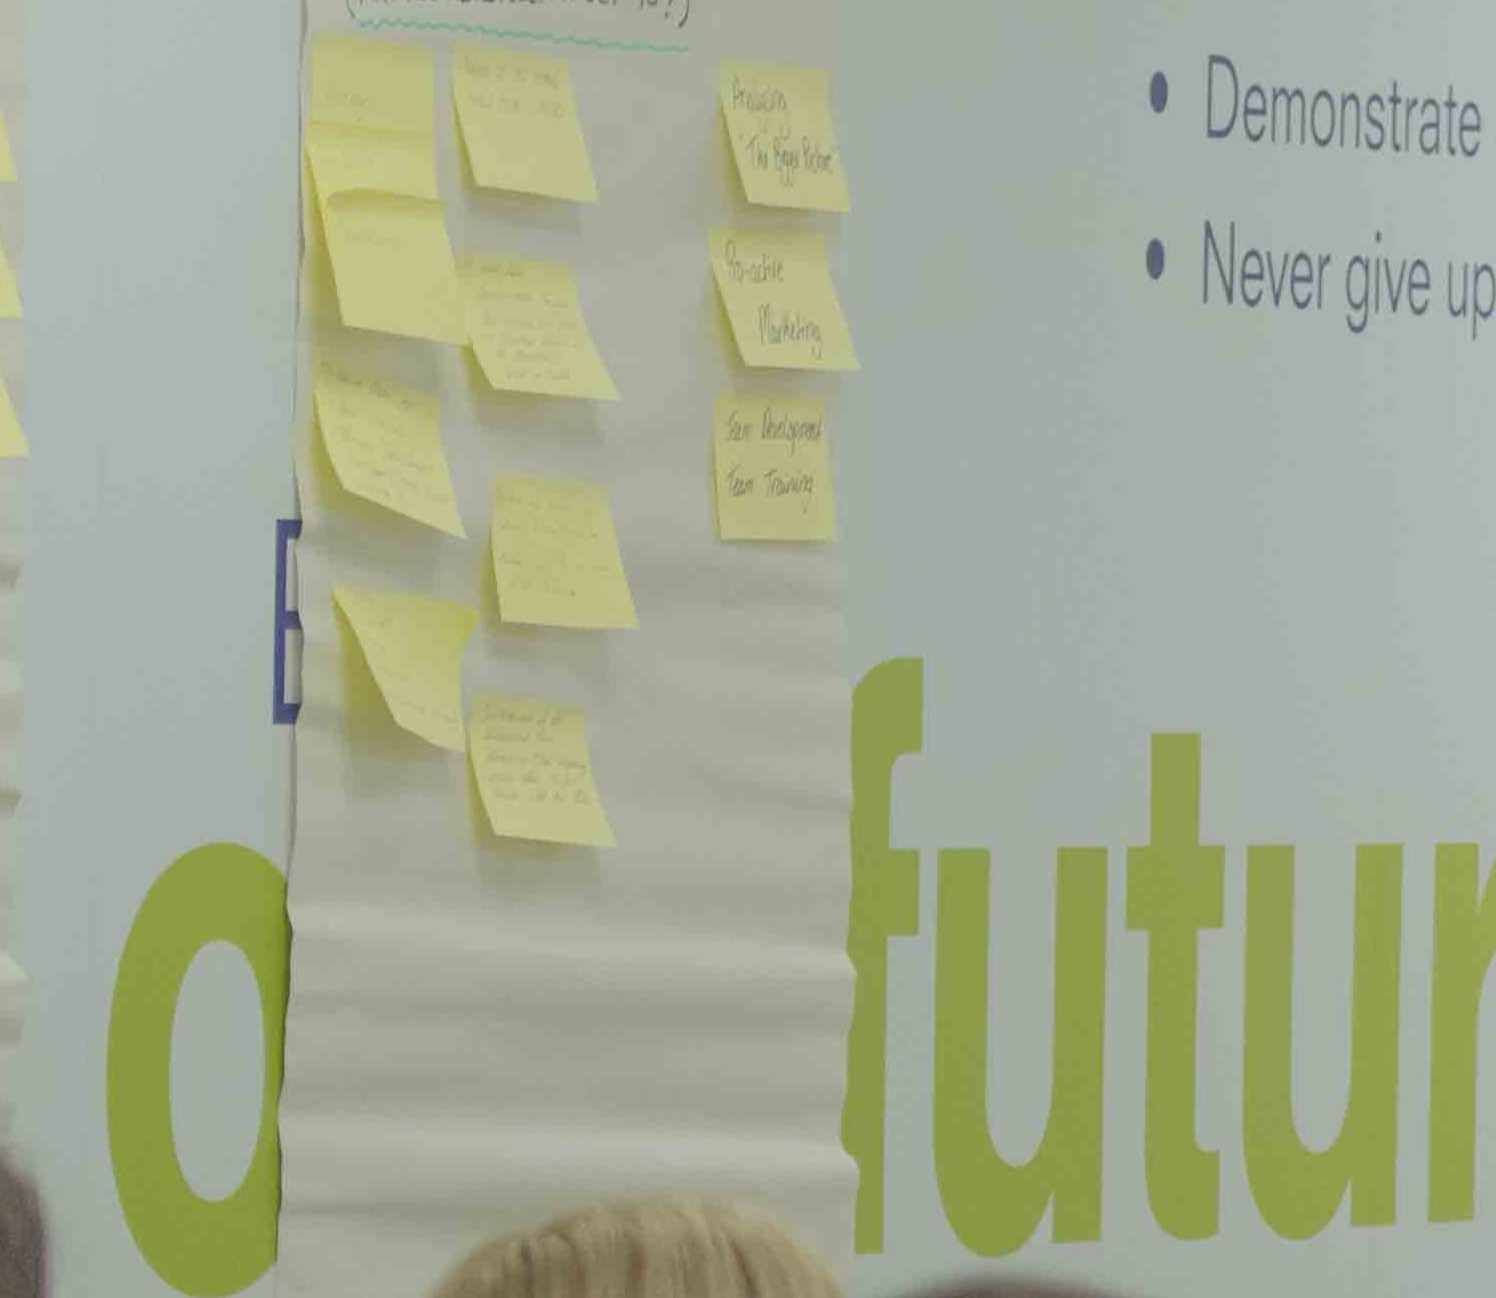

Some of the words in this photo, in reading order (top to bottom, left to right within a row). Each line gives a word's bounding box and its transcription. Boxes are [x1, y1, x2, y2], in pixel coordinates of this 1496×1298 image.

[1206, 54, 1482, 158] Demonstrate
[1202, 219, 1331, 311] Never
[1346, 231, 1432, 335] give
[1447, 256, 1496, 341] up
[757, 303, 823, 360] Marketing
[727, 464, 755, 497] Team
[763, 467, 816, 514] Training
